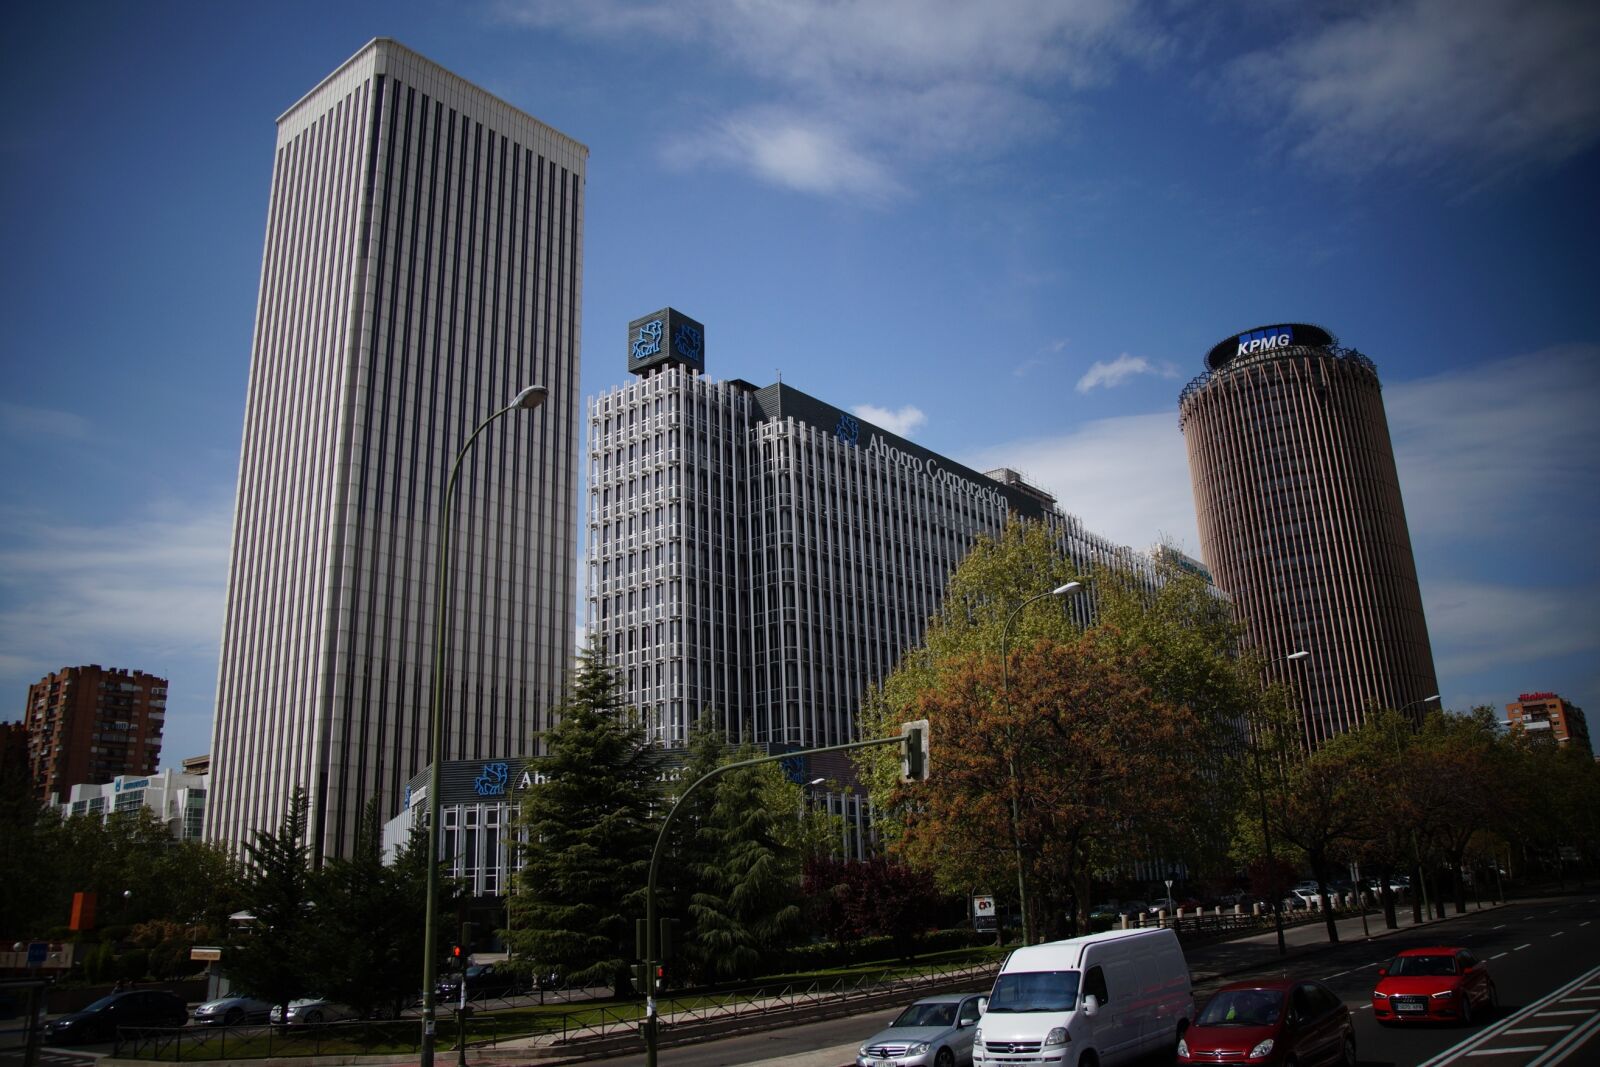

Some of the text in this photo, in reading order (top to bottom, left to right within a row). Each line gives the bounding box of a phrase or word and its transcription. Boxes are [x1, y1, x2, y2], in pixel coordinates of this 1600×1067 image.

[1237, 333, 1289, 355] KPMG
[868, 433, 1008, 509] Ahorro Corporación
